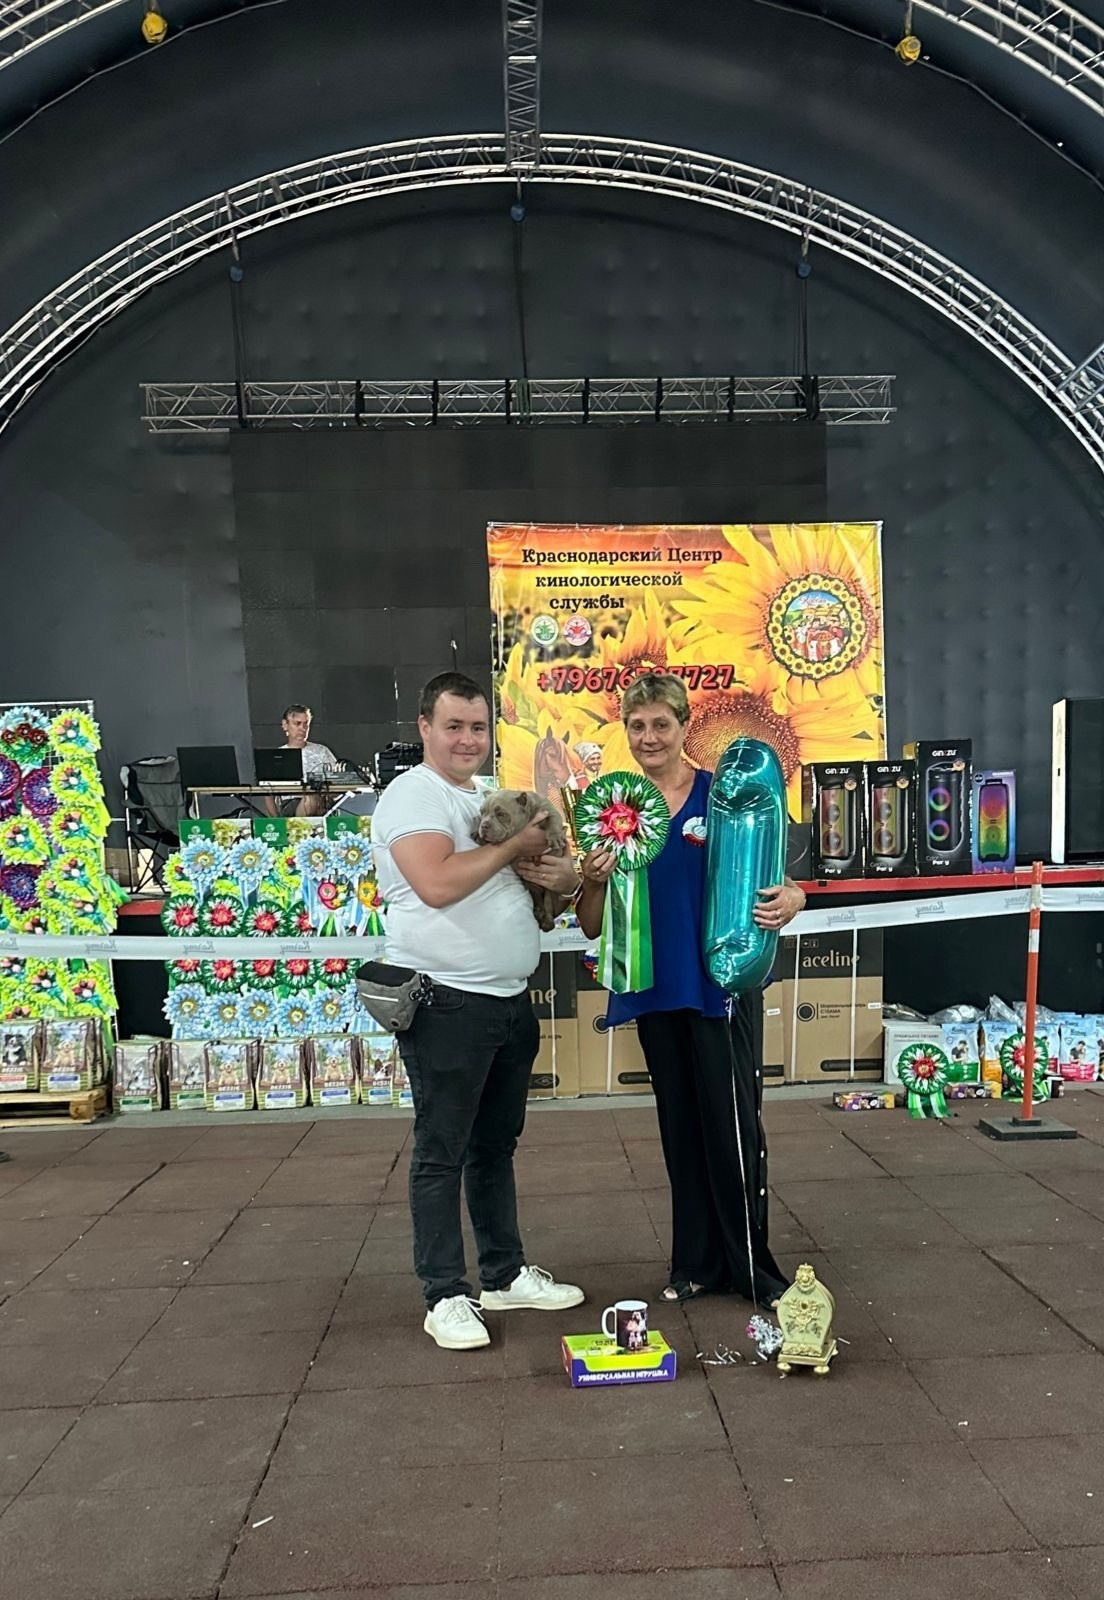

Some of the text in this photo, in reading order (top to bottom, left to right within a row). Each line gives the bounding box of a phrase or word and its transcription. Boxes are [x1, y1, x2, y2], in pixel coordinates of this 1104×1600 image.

[522, 547, 723, 565] Краснодарский Центр
[535, 571, 683, 588] кинологической
[549, 594, 625, 613] службы
[537, 664, 735, 692] +79676727
[578, 1369, 669, 1382] УНИВЕРСАЛЬНАЯ ИГРУШКА
